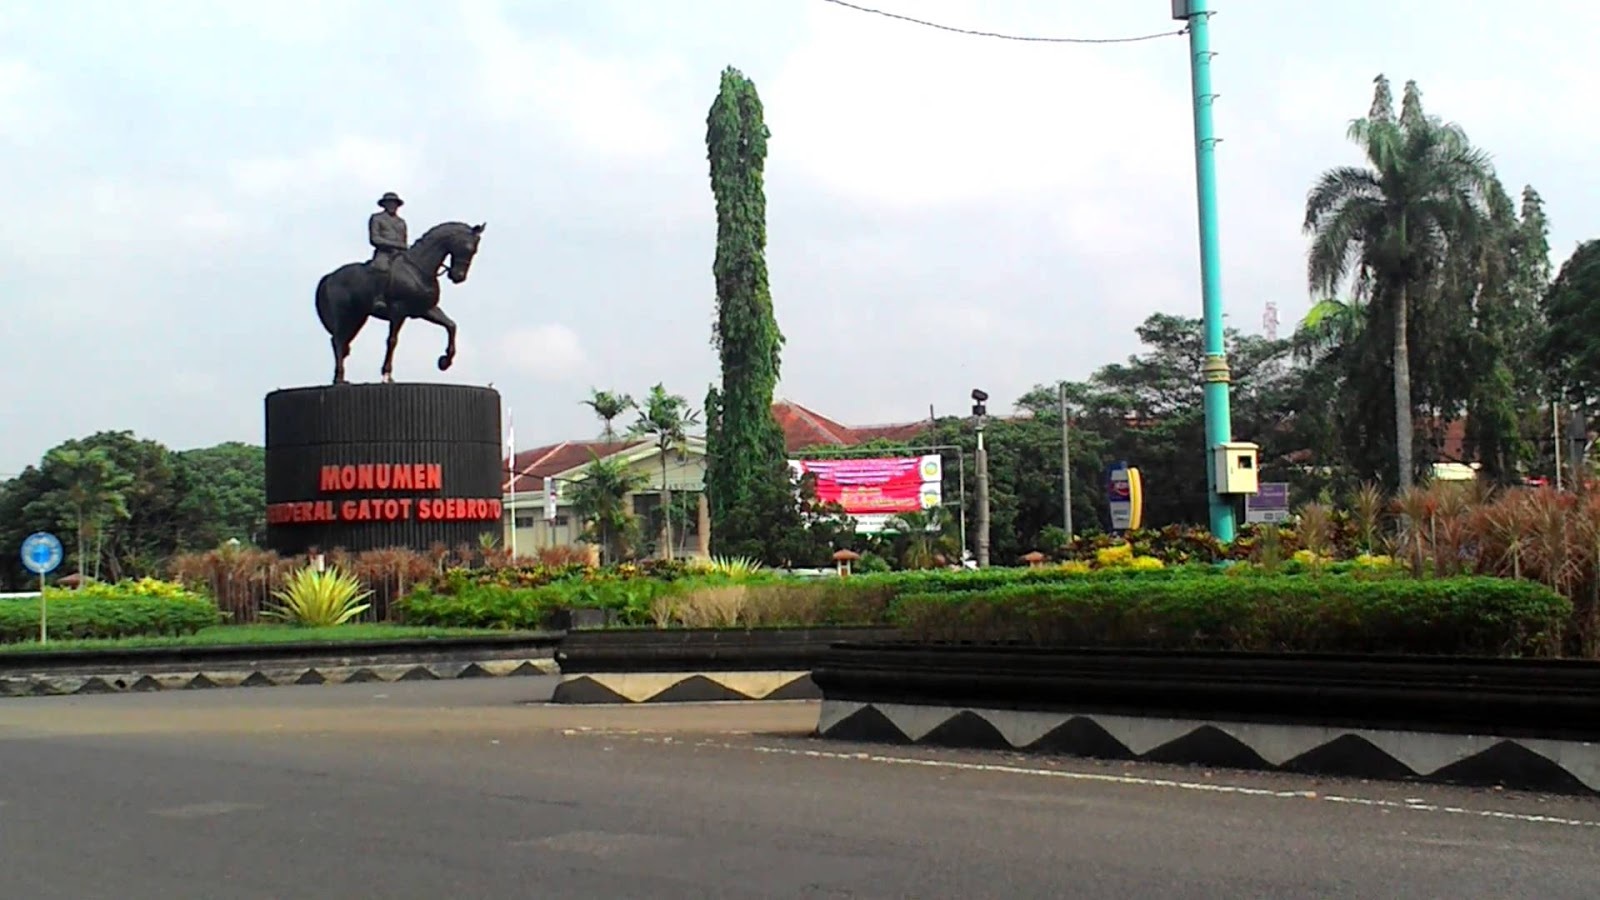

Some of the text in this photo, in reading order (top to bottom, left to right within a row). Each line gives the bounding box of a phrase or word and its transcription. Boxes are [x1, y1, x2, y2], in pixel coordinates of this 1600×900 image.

[320, 463, 442, 491] MONUMEN
[341, 498, 412, 520] GATOT
[418, 498, 502, 520] SOEBROTO
